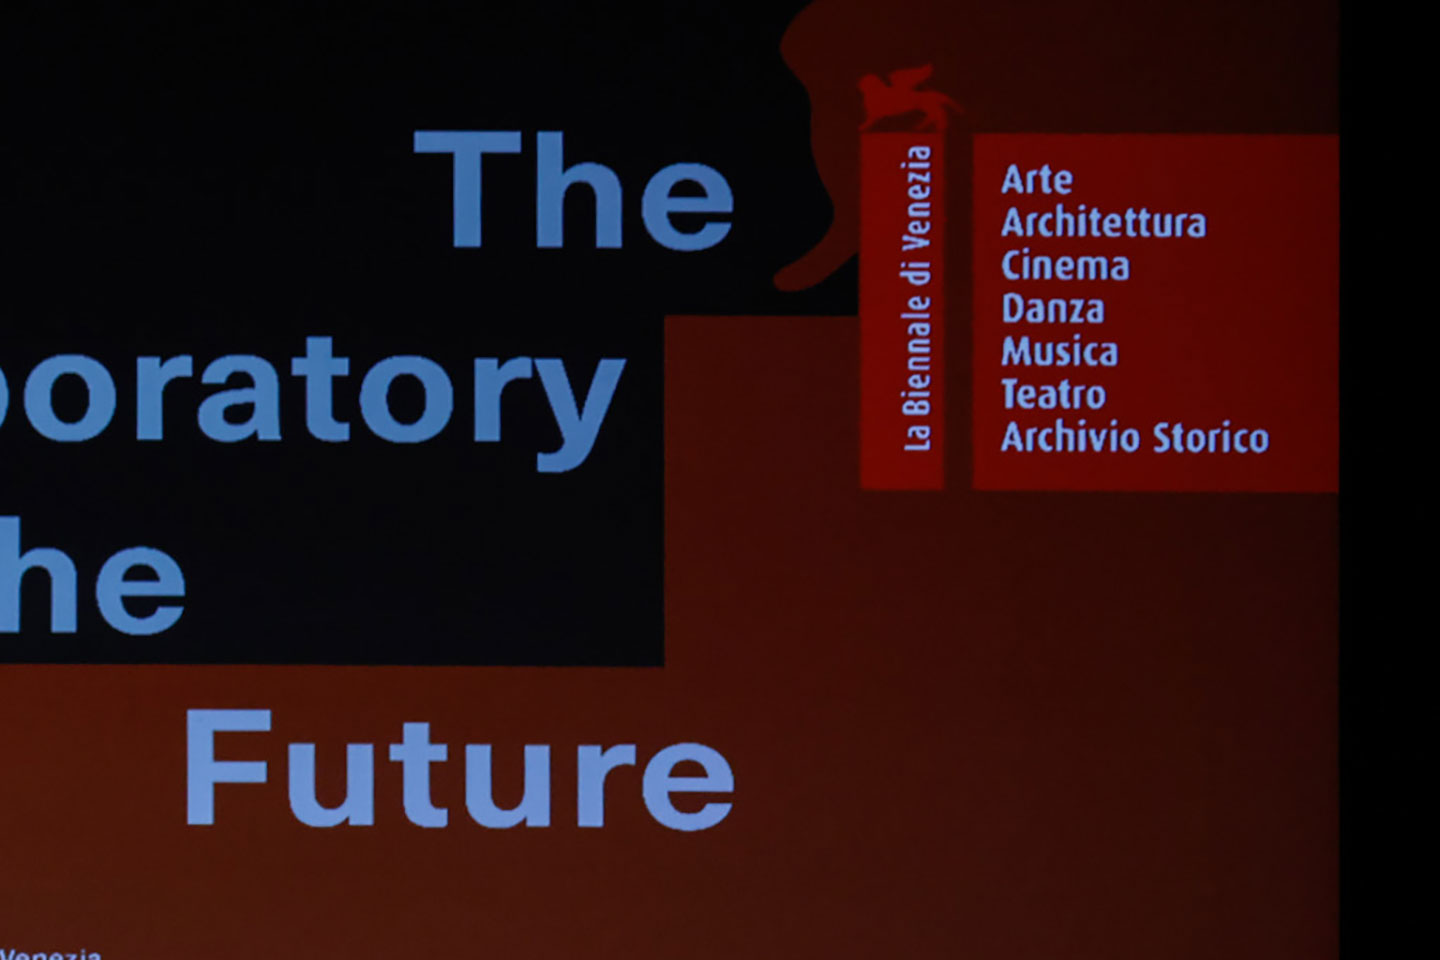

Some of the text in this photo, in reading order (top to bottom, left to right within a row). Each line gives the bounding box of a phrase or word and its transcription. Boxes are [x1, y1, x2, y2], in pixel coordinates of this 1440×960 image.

[414, 131, 733, 250] The
[1002, 164, 1073, 194] Arte
[1002, 204, 1206, 237] Architettura
[1002, 248, 1129, 280] Cinema
[900, 146, 931, 450] La Biennale di Venezia
[1003, 293, 1104, 323] Danza
[1002, 334, 1118, 366] Musica
[1002, 378, 1106, 409] Teatro
[1001, 419, 1269, 453] Archivio Storico
[187, 709, 734, 831] Future
